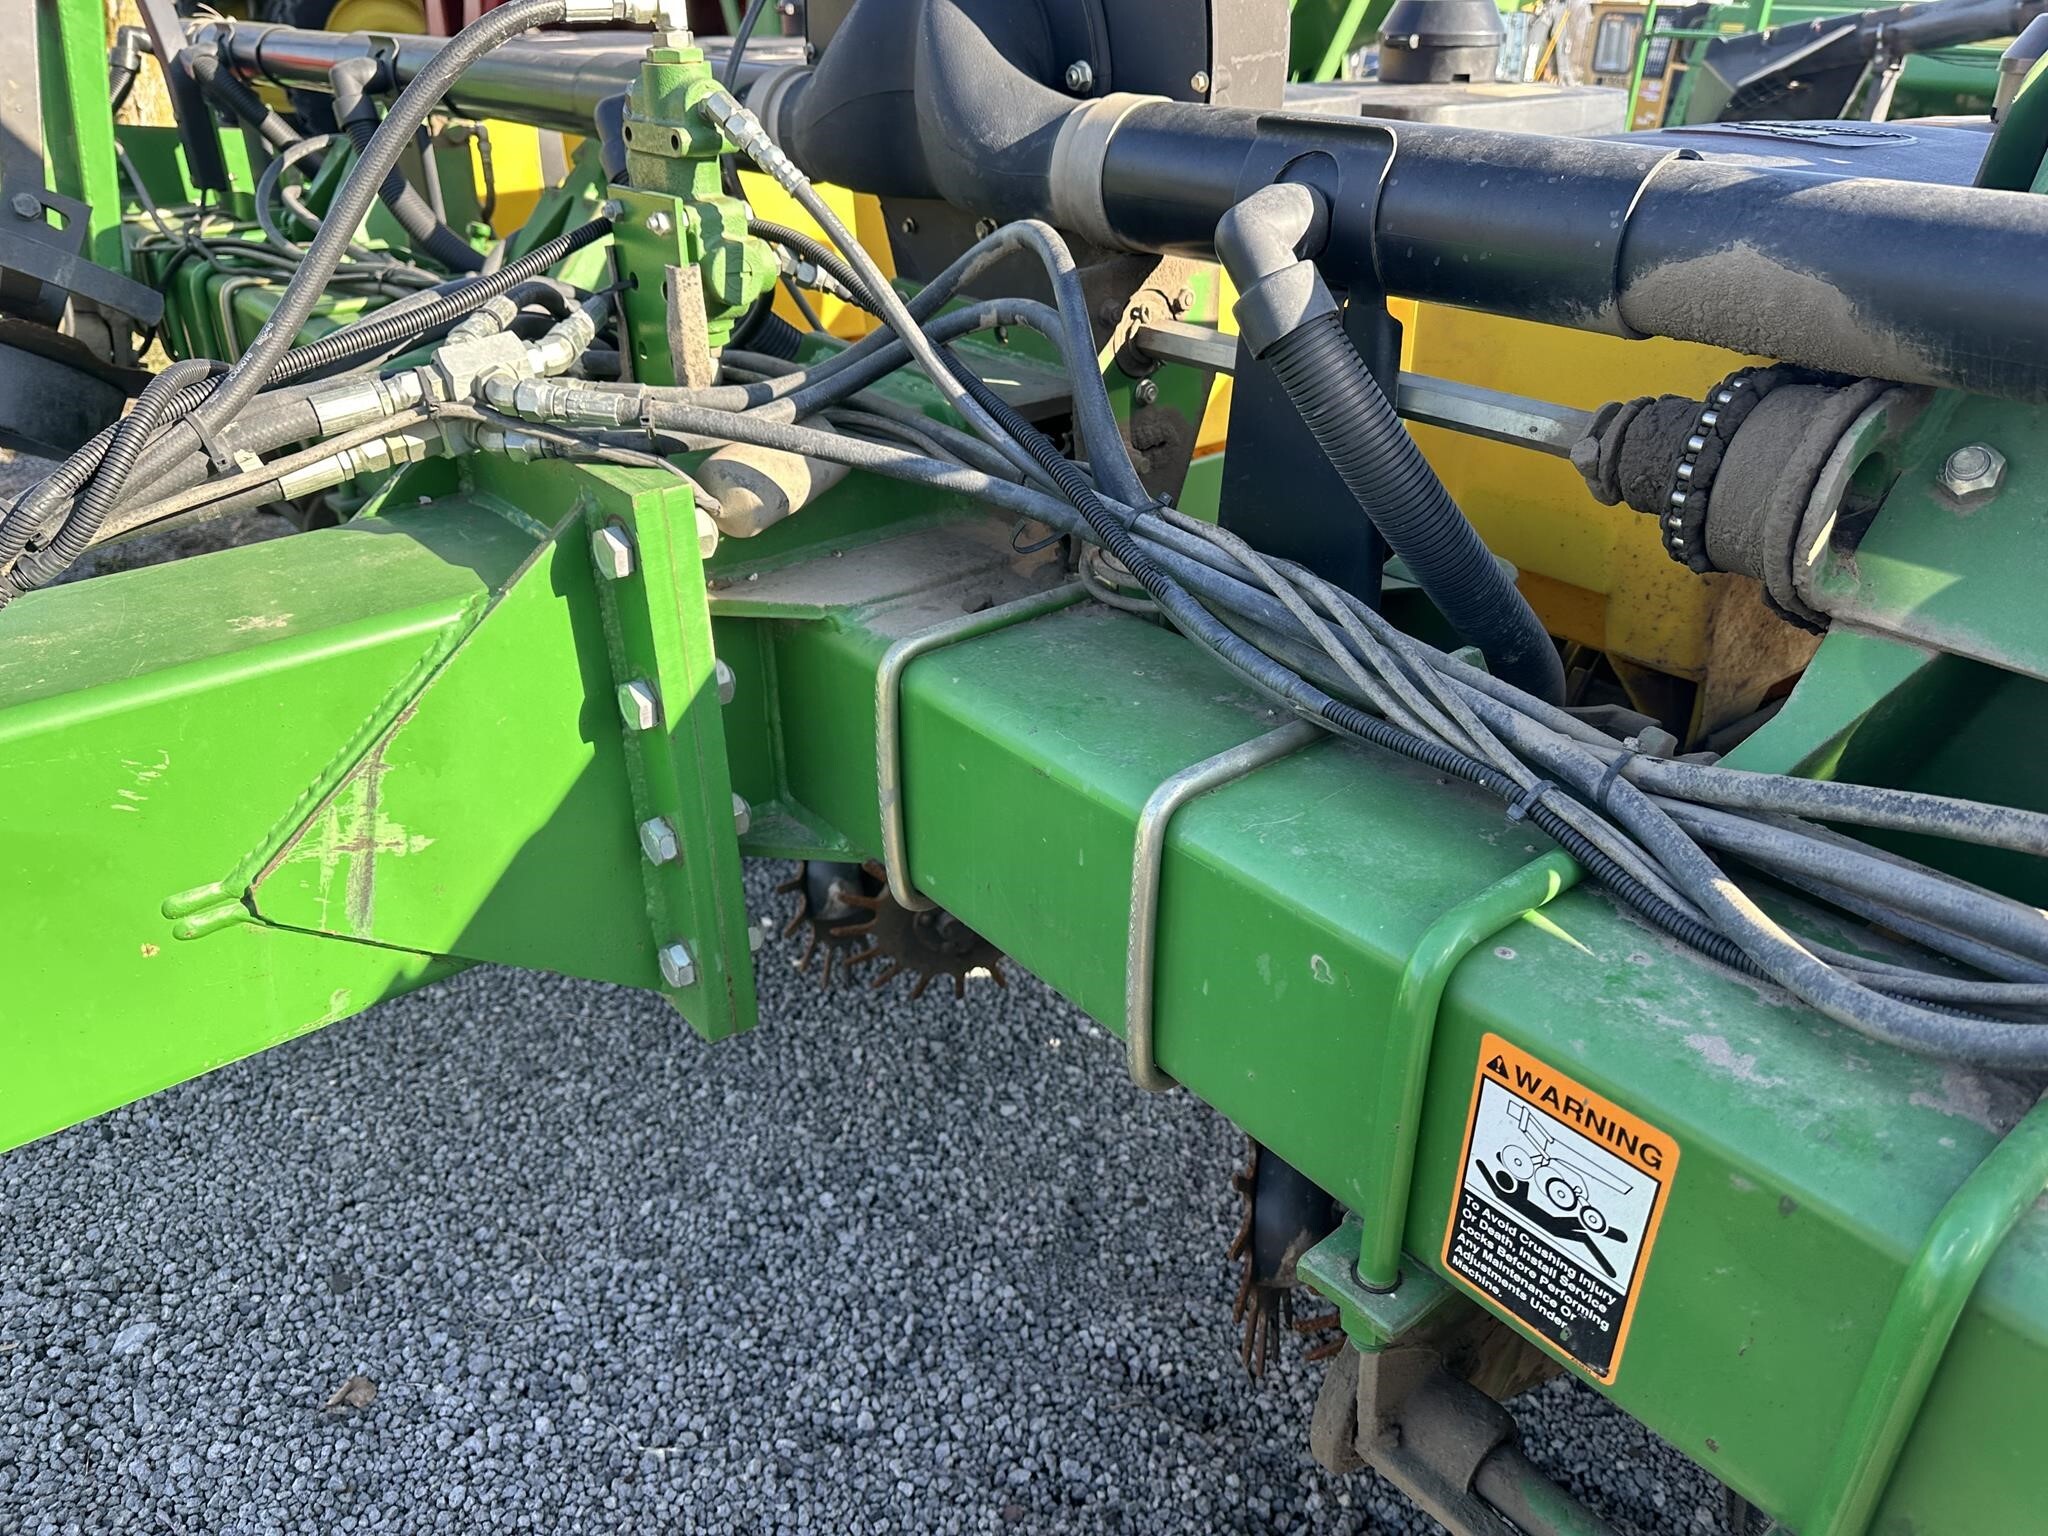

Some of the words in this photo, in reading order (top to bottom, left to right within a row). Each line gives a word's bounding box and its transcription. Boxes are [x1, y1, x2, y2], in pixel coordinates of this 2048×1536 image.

[1515, 1065, 1663, 1171] WARNING
[1452, 1255, 1502, 1298] Machine.
[1454, 1245, 1527, 1301] Adjustments
[1529, 1297, 1568, 1328] Under
[1457, 1233, 1480, 1254] Any
[1482, 1249, 1558, 1308] Maintenance
[1560, 1305, 1577, 1320] Or
[1460, 1220, 1494, 1249] Locks
[1496, 1245, 1537, 1279] Before
[1539, 1275, 1610, 1332] Performing
[1462, 1208, 1477, 1222] Or
[1479, 1219, 1516, 1252] Death,
[1519, 1246, 1557, 1279] Install
[1560, 1275, 1607, 1313] Service
[1465, 1194, 1480, 1211] To
[1481, 1208, 1517, 1237] Avoid
[1519, 1232, 1577, 1280] Crushing
[1579, 1273, 1617, 1305] Injury
